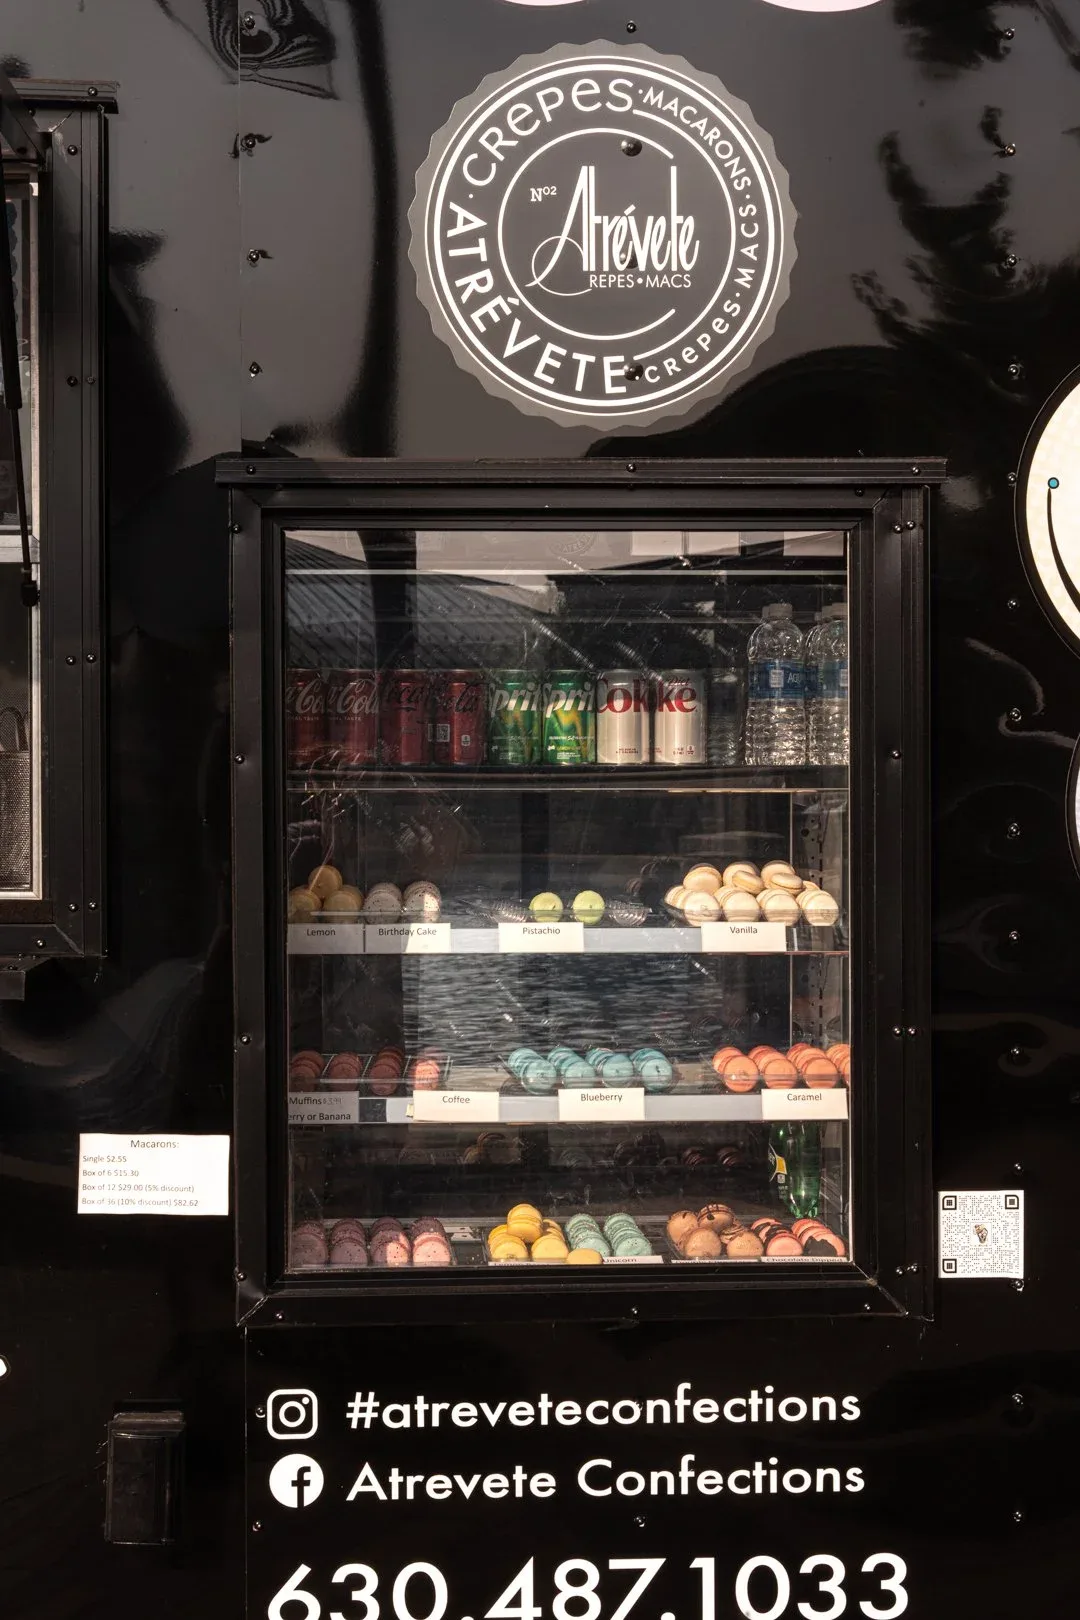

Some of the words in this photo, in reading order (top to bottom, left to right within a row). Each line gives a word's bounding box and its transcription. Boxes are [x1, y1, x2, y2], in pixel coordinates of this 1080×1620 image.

[643, 86, 752, 191] MACARONS
[735, 204, 758, 289] MACS
[447, 202, 627, 394] ATRÉVETE
[306, 928, 336, 937] Lemon
[378, 927, 414, 938] Birthday
[416, 927, 437, 936] Cake
[522, 926, 561, 935] Pistachio
[729, 926, 758, 934] Vanilla
[289, 1096, 322, 1105] Muffins
[442, 1095, 470, 1103] Coffee
[580, 1093, 623, 1103] Blueberry
[787, 1093, 822, 1101] Caramel
[319, 1112, 351, 1121] Banana
[130, 1140, 179, 1148] Macarons:
[346, 1382, 861, 1429] #atreveteconfections
[346, 1461, 556, 1501] Atrevete
[577, 1454, 865, 1498] Confections
[267, 1553, 909, 1620] 630487.1033
